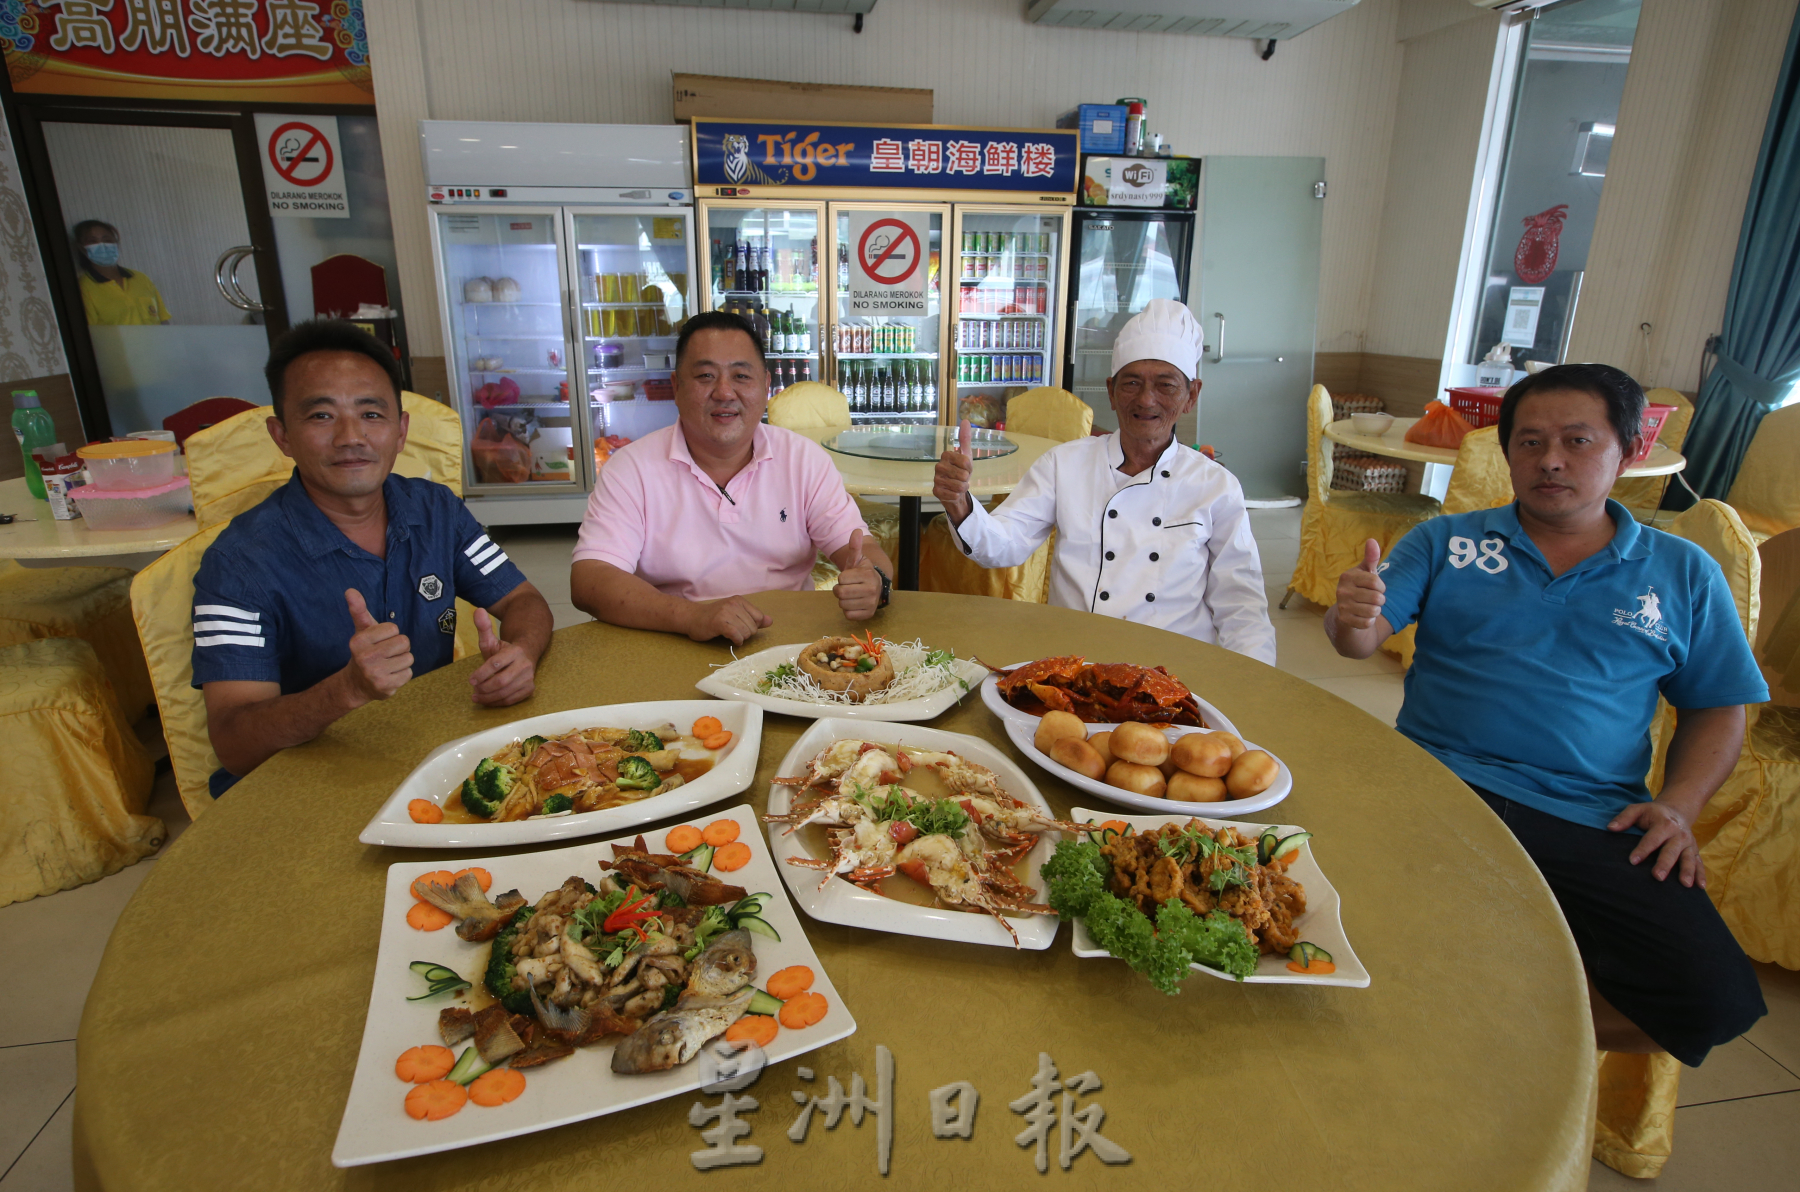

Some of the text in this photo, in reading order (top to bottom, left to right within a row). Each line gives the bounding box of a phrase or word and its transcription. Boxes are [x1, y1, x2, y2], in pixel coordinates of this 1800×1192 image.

[38, 0, 333, 60] 高朋满座
[757, 131, 855, 181] Tiger
[869, 138, 1056, 178] 皇朝海鲜楼
[270, 191, 306, 200] DILARANG
[272, 202, 345, 211] NO SMOKING
[853, 290, 924, 299] DILARANG MEROKOK
[853, 301, 924, 309] NO SMOKING
[1448, 535, 1508, 575] 98
[1613, 607, 1633, 617] POLO
